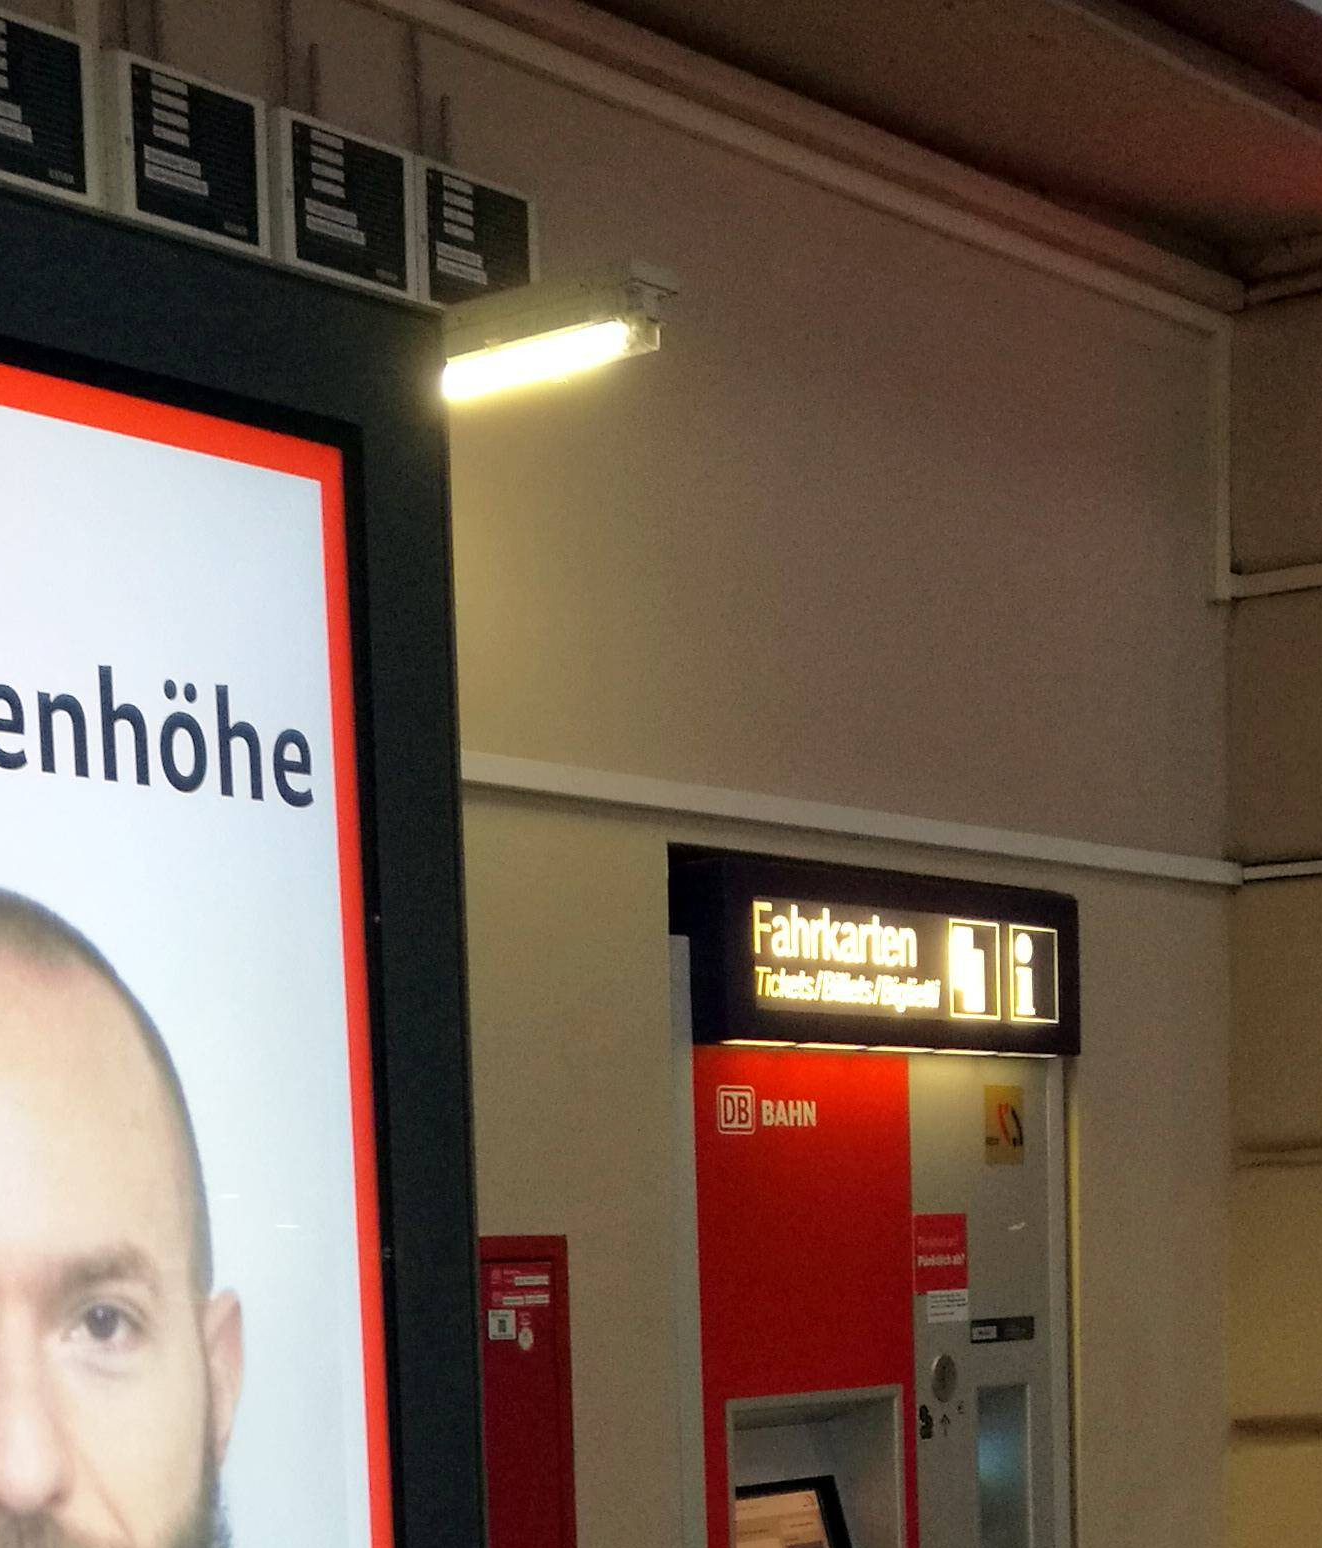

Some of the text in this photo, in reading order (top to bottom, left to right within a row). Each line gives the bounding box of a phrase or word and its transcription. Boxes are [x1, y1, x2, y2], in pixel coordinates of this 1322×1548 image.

[752, 900, 918, 968] Fahrkarten
[721, 1091, 818, 1128] DB BAHN
